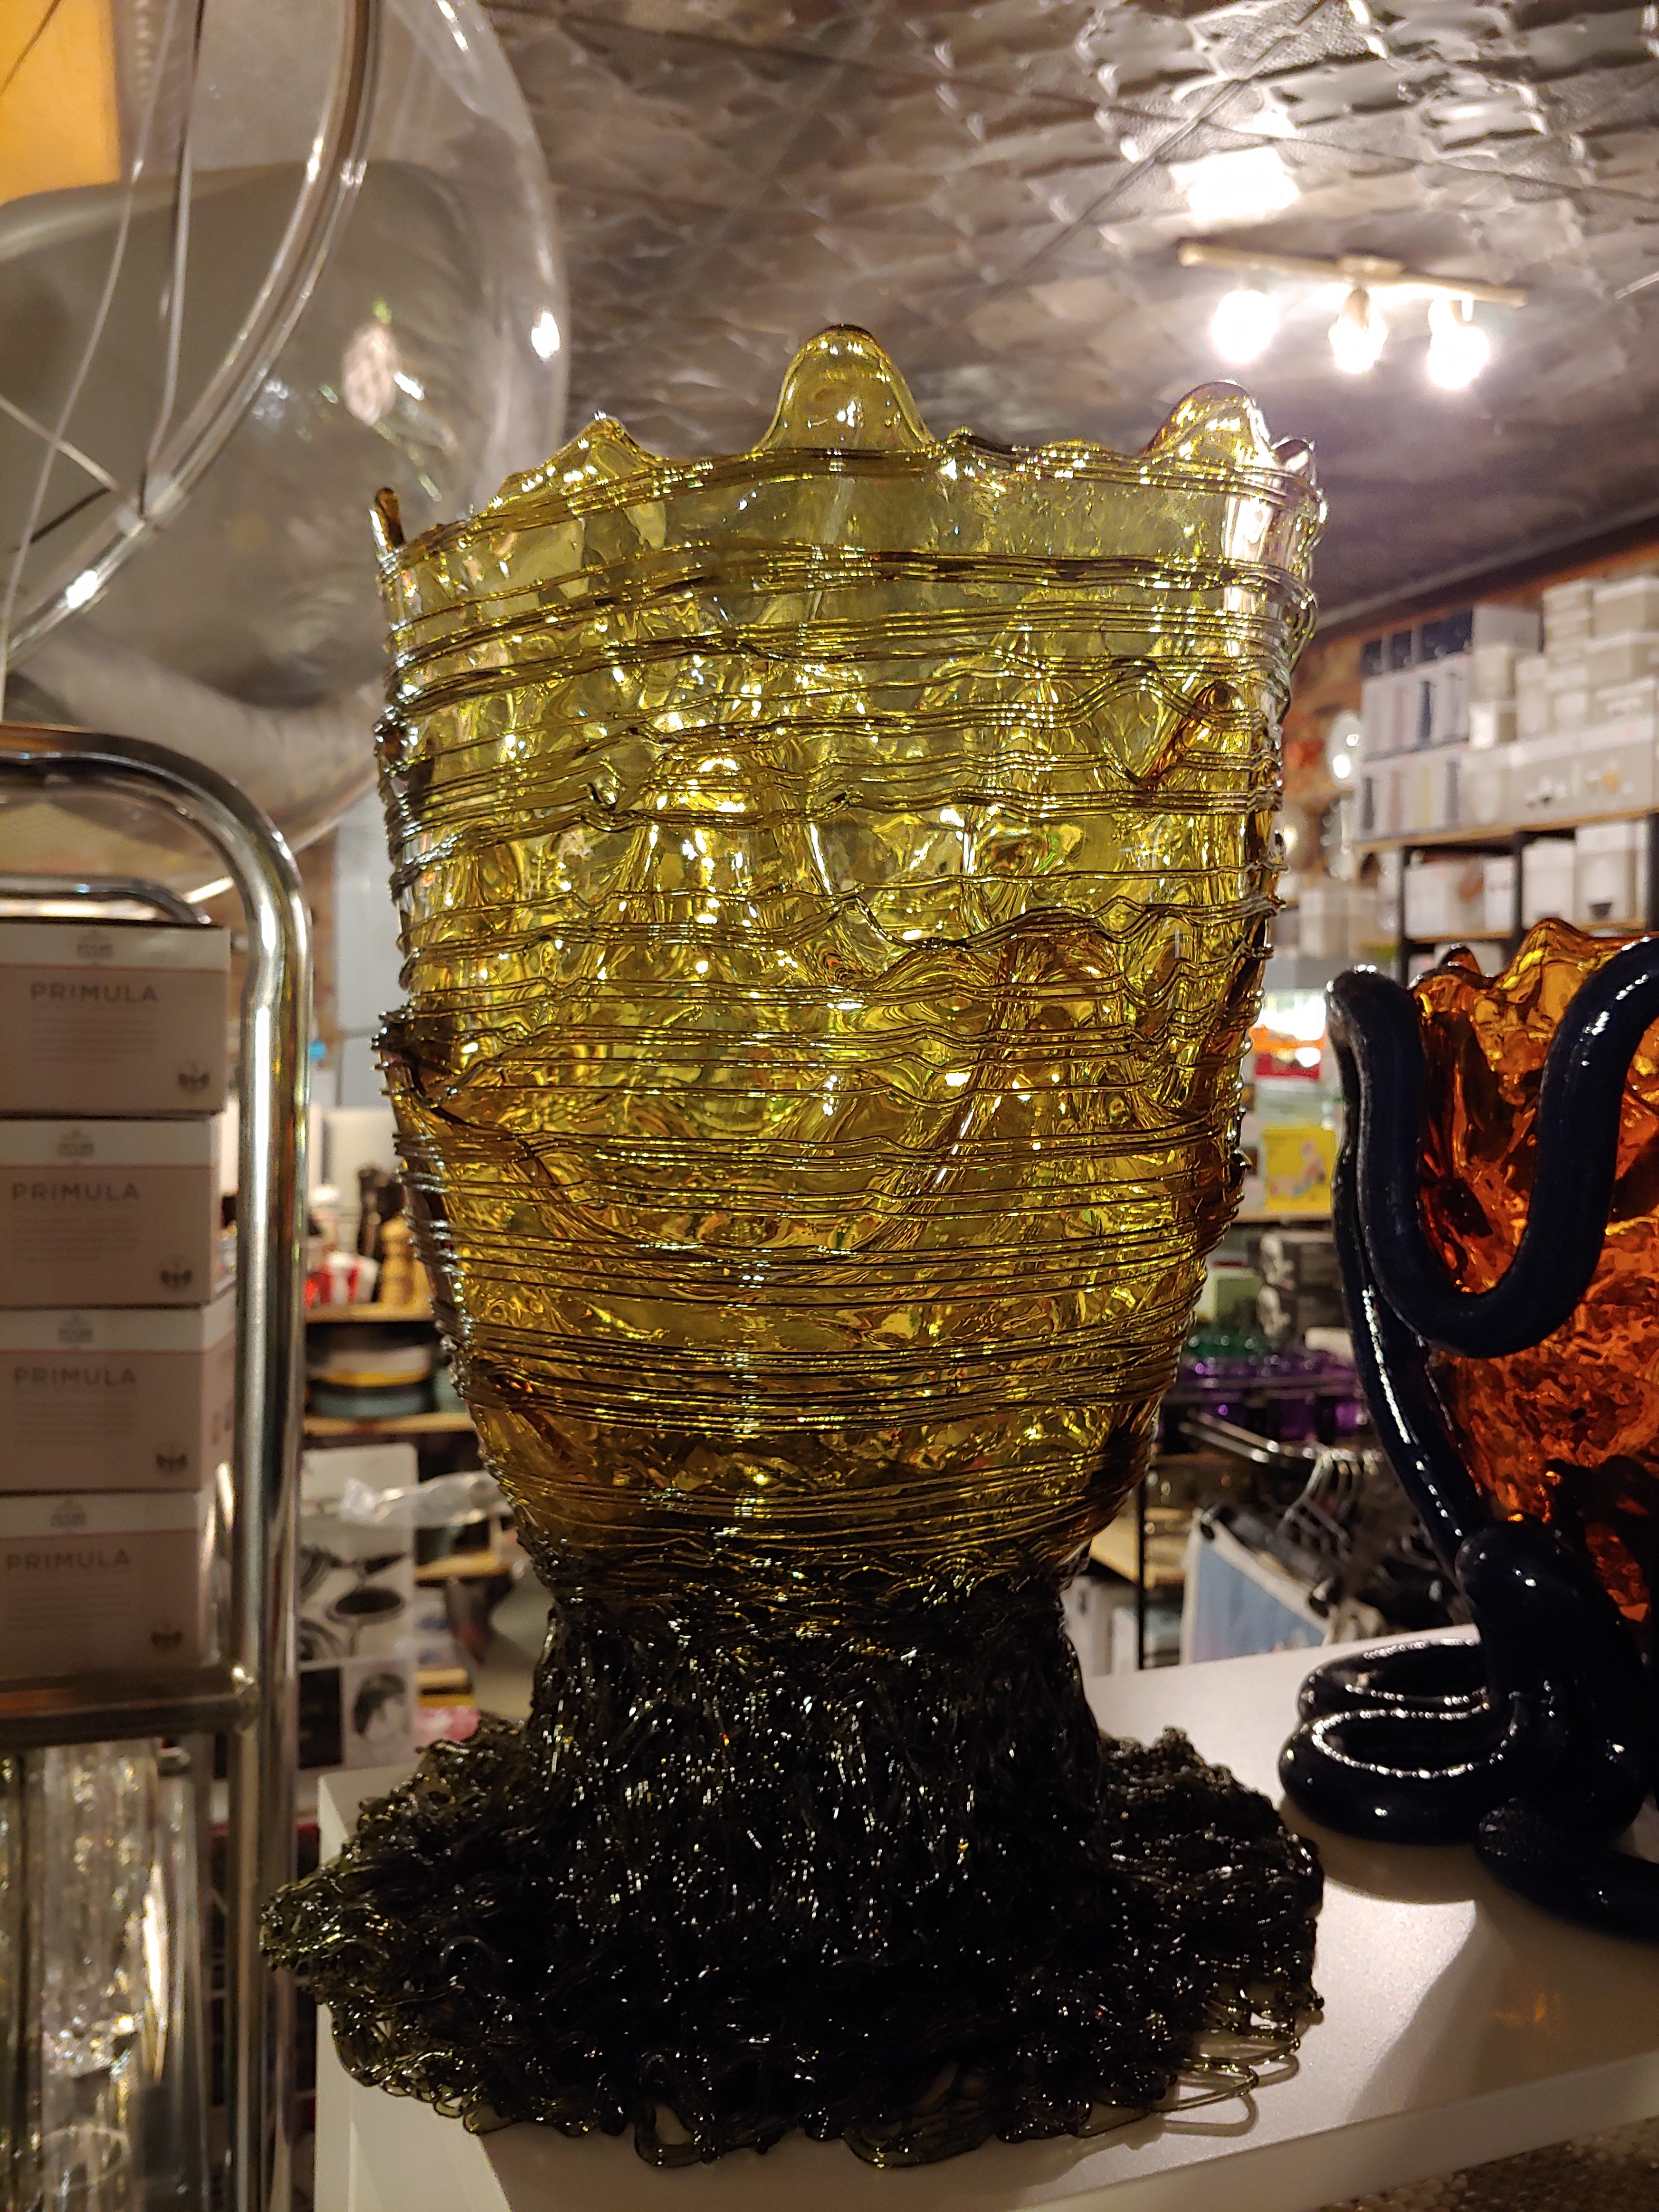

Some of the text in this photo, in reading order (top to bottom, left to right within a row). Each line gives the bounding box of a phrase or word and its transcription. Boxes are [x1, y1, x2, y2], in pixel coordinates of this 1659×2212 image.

[30, 981, 158, 1003] PRIMULA
[11, 1182, 140, 1201] PRIMULA
[14, 1366, 137, 1386] PRIMULA
[5, 1548, 131, 1571] PRIMULA
